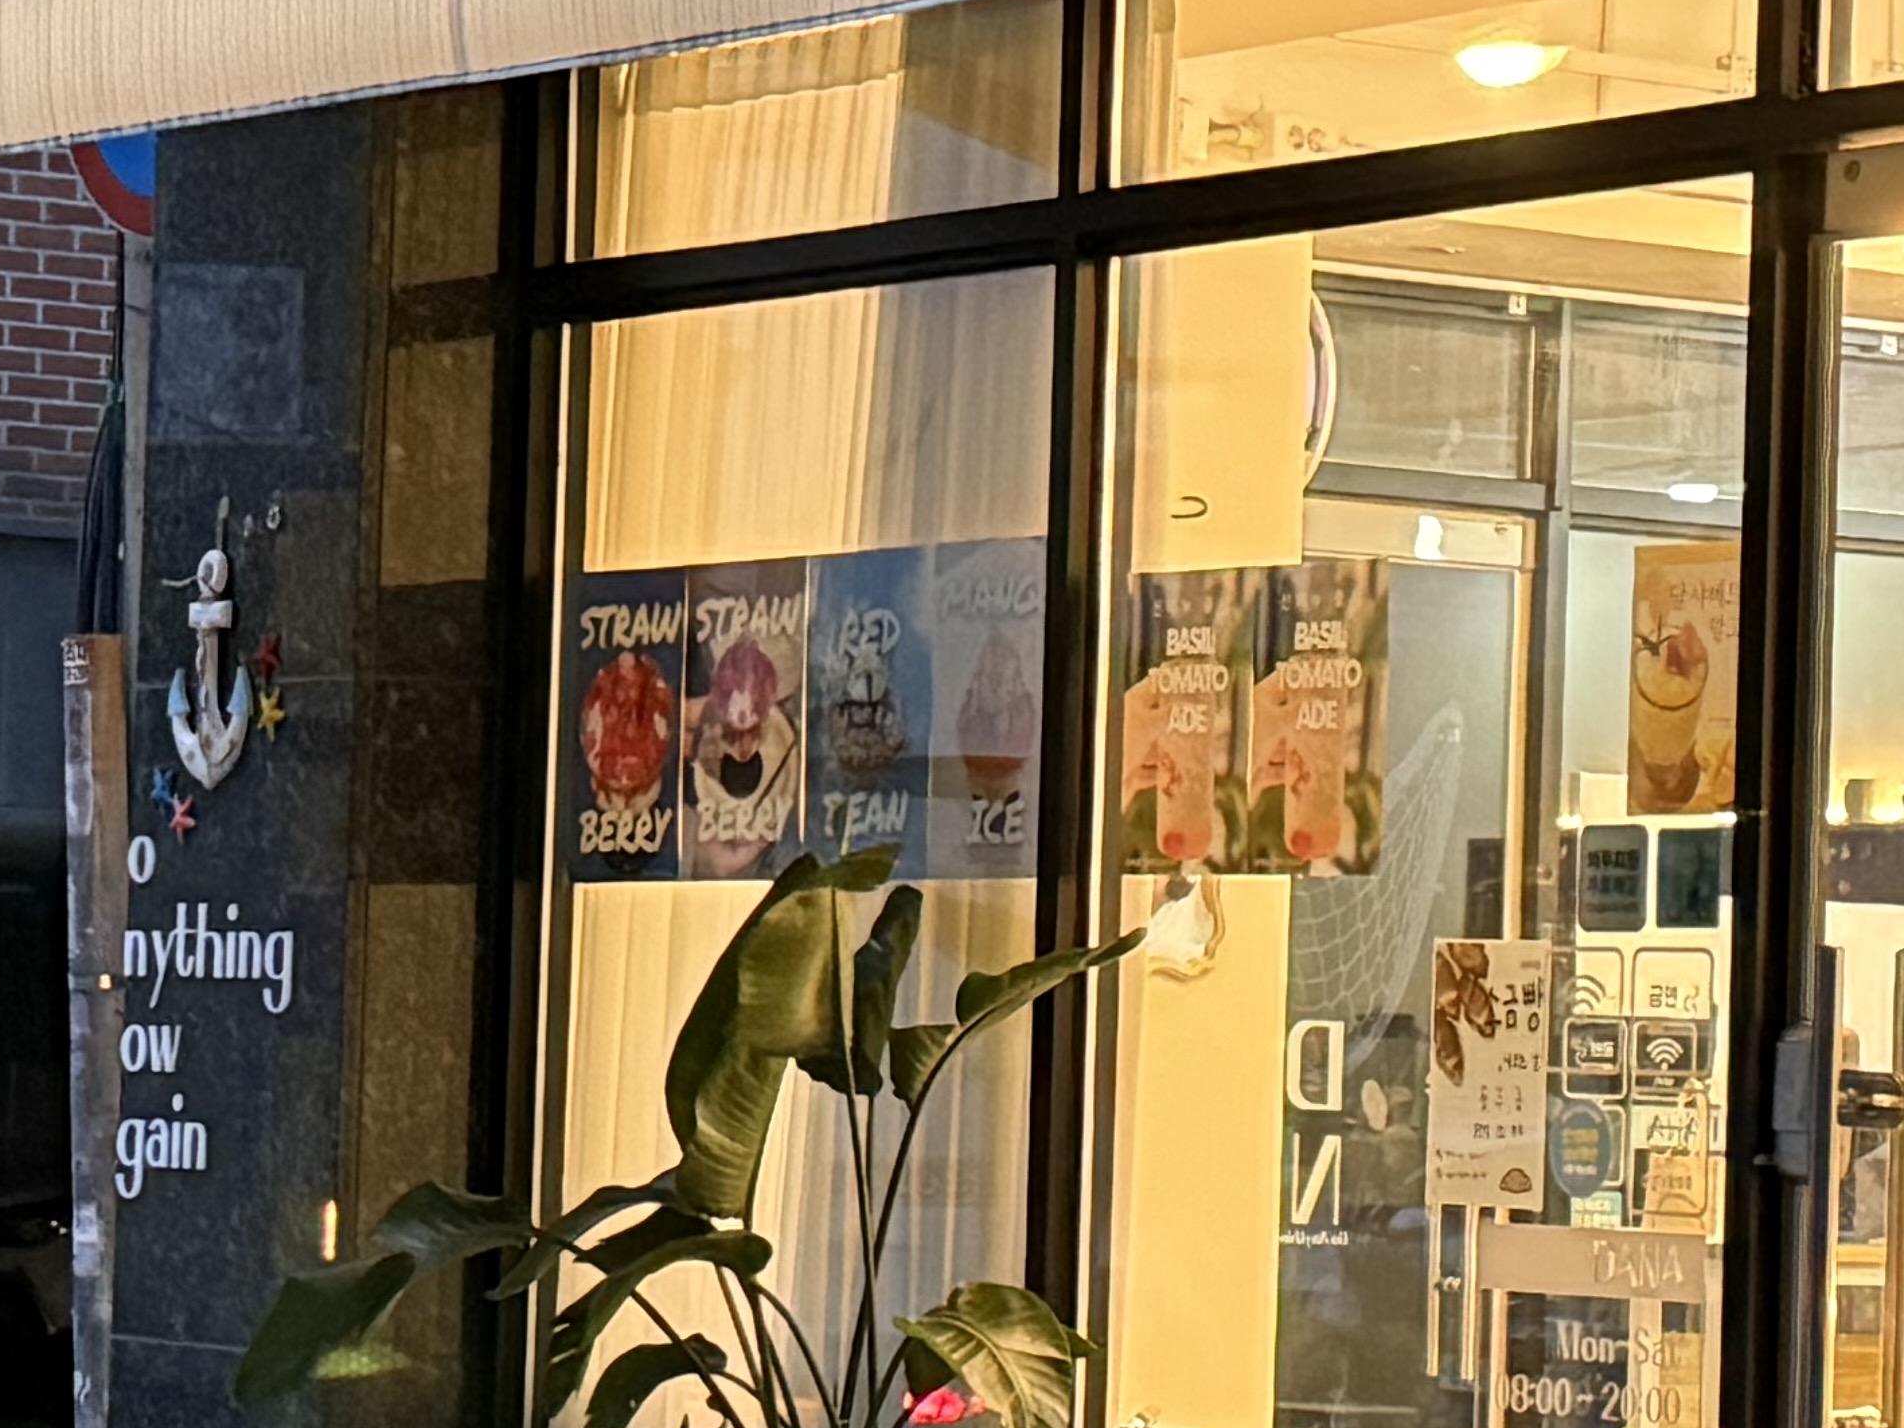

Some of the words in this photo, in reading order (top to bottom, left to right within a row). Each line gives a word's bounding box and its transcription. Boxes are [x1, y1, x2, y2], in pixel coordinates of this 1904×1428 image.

[579, 601, 682, 649] STRAW
[696, 593, 805, 643] STRAW
[834, 607, 901, 659] RED
[1165, 625, 1217, 657] BASIL
[1294, 619, 1347, 652] BASIL
[1148, 663, 1229, 694] TOMATO
[1275, 658, 1363, 691] TOMATO
[1167, 703, 1208, 734] ADE
[1295, 699, 1339, 730] ADE
[578, 806, 673, 856] BERRY
[697, 795, 790, 844] BERRY
[965, 793, 1026, 845] ICE
[122, 902, 295, 1014] nything
[119, 1023, 183, 1073] ow
[114, 1093, 208, 1200] gain
[1592, 1239, 1684, 1289] DANA
